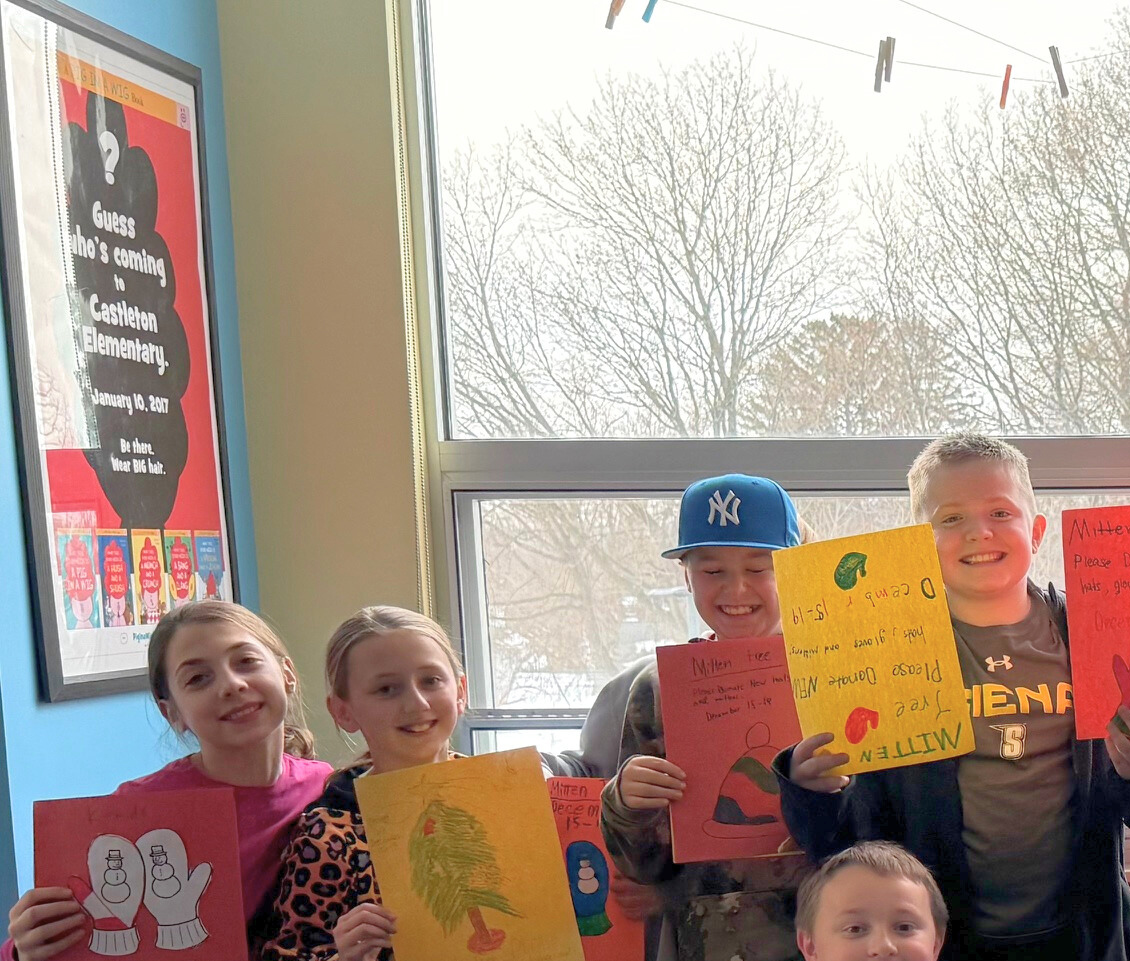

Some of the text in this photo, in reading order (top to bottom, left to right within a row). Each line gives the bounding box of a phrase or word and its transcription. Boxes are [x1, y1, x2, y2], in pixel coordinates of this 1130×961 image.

[111, 83, 129, 99] WIG
[92, 200, 136, 239] Guess
[113, 246, 167, 288] coming
[113, 273, 126, 292] to
[89, 293, 159, 334] Castleton
[82, 325, 170, 377] Elementary.
[91, 388, 133, 416] January
[149, 394, 169, 414] 2017
[120, 437, 155, 456] Be there.
[111, 456, 167, 475] Wear BIG hair.
[707, 489, 742, 527] NY
[1074, 553, 1112, 570] Please
[824, 644, 840, 655] and
[854, 629, 885, 648] gloves
[828, 667, 877, 689] Donate
[892, 659, 942, 683] Please
[895, 689, 951, 720] Tree
[859, 722, 962, 763] MITTEN
